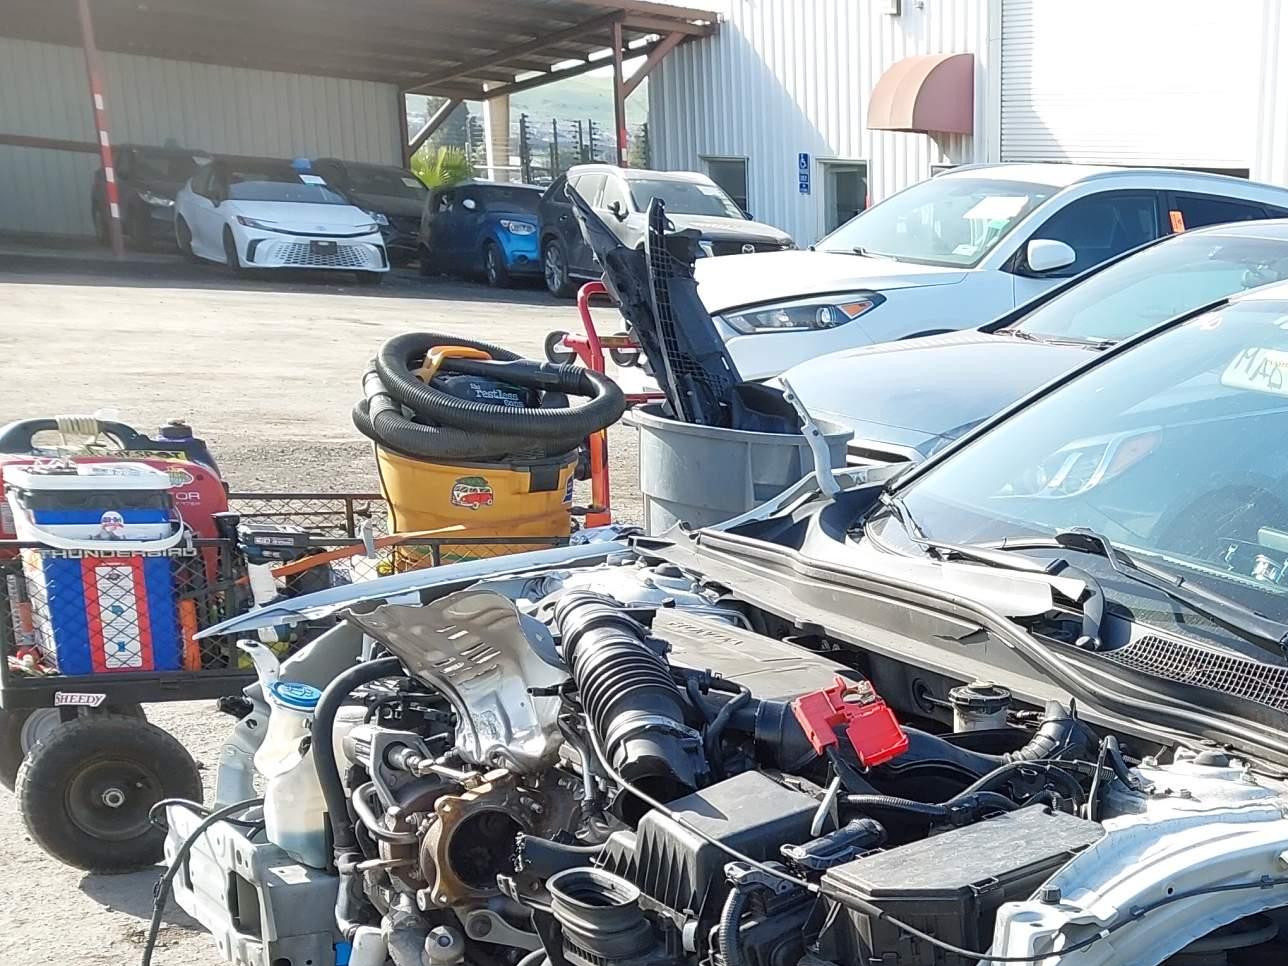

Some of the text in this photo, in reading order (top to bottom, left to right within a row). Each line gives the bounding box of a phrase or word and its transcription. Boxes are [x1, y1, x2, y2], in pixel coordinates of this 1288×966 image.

[1232, 347, 1283, 390] MAD
[475, 389, 519, 401] restless
[42, 547, 197, 559] THUNDERBIRD
